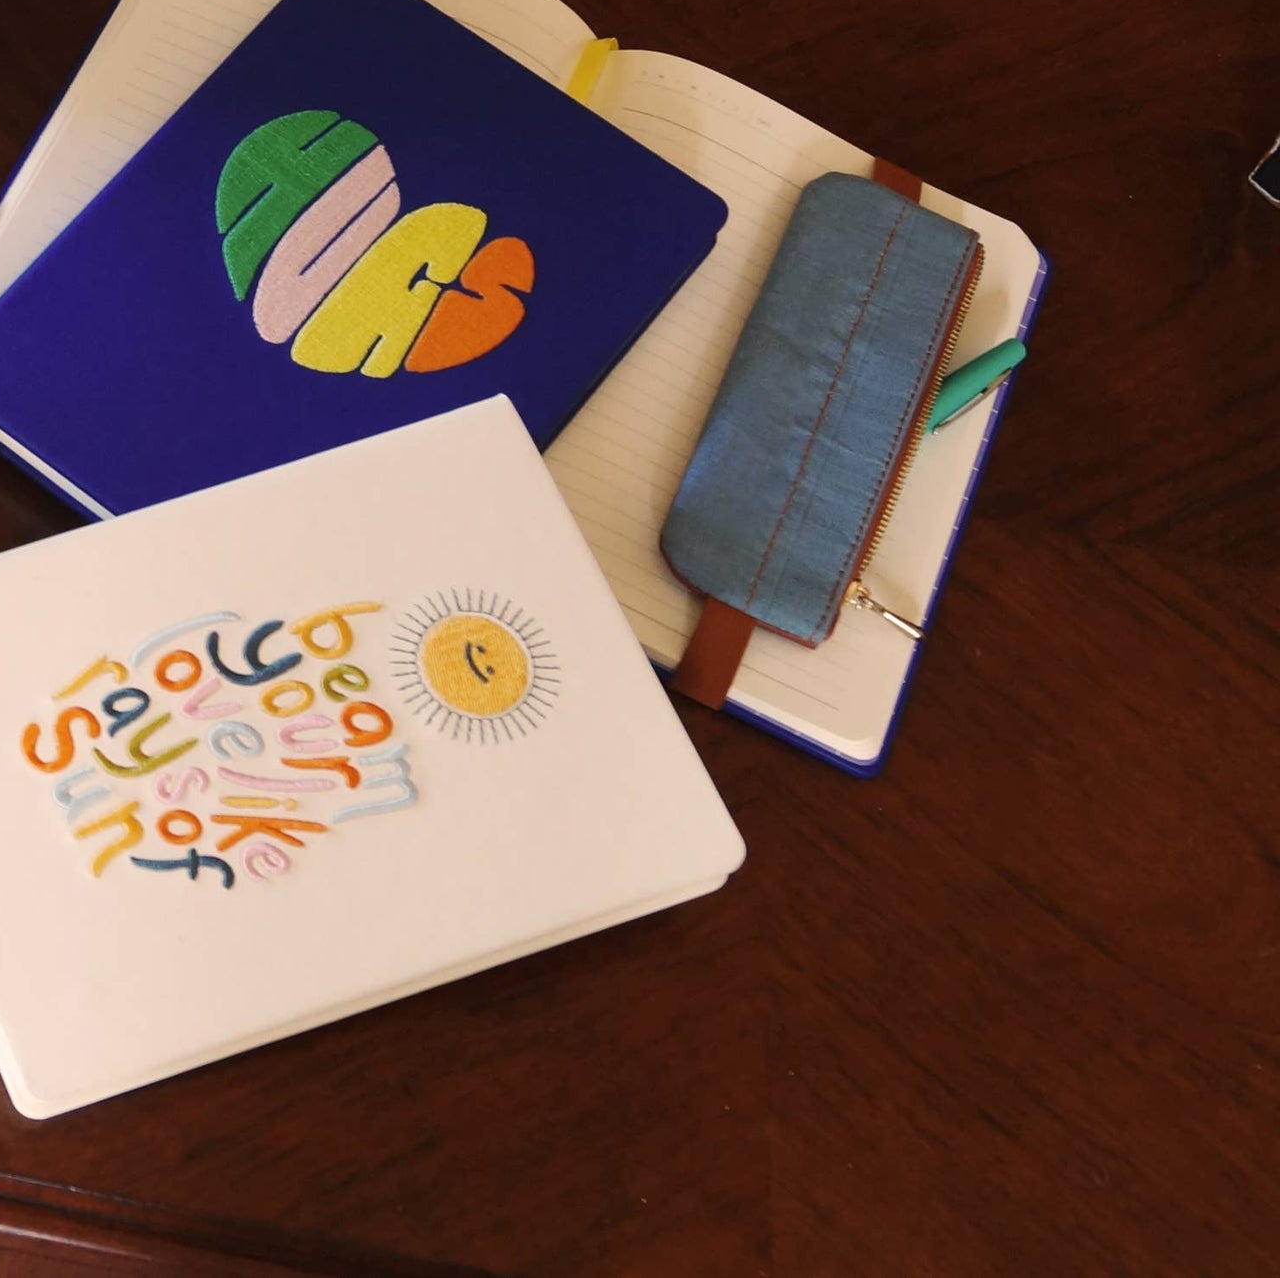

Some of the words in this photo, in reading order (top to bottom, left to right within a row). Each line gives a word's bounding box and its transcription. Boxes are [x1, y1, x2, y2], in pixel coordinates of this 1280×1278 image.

[215, 109, 535, 379] HUGS
[51, 653, 210, 803] rays
[130, 610, 266, 760] love
[210, 765, 337, 881] like
[205, 619, 362, 790] your
[290, 601, 419, 824] beam
[130, 808, 236, 890] of
